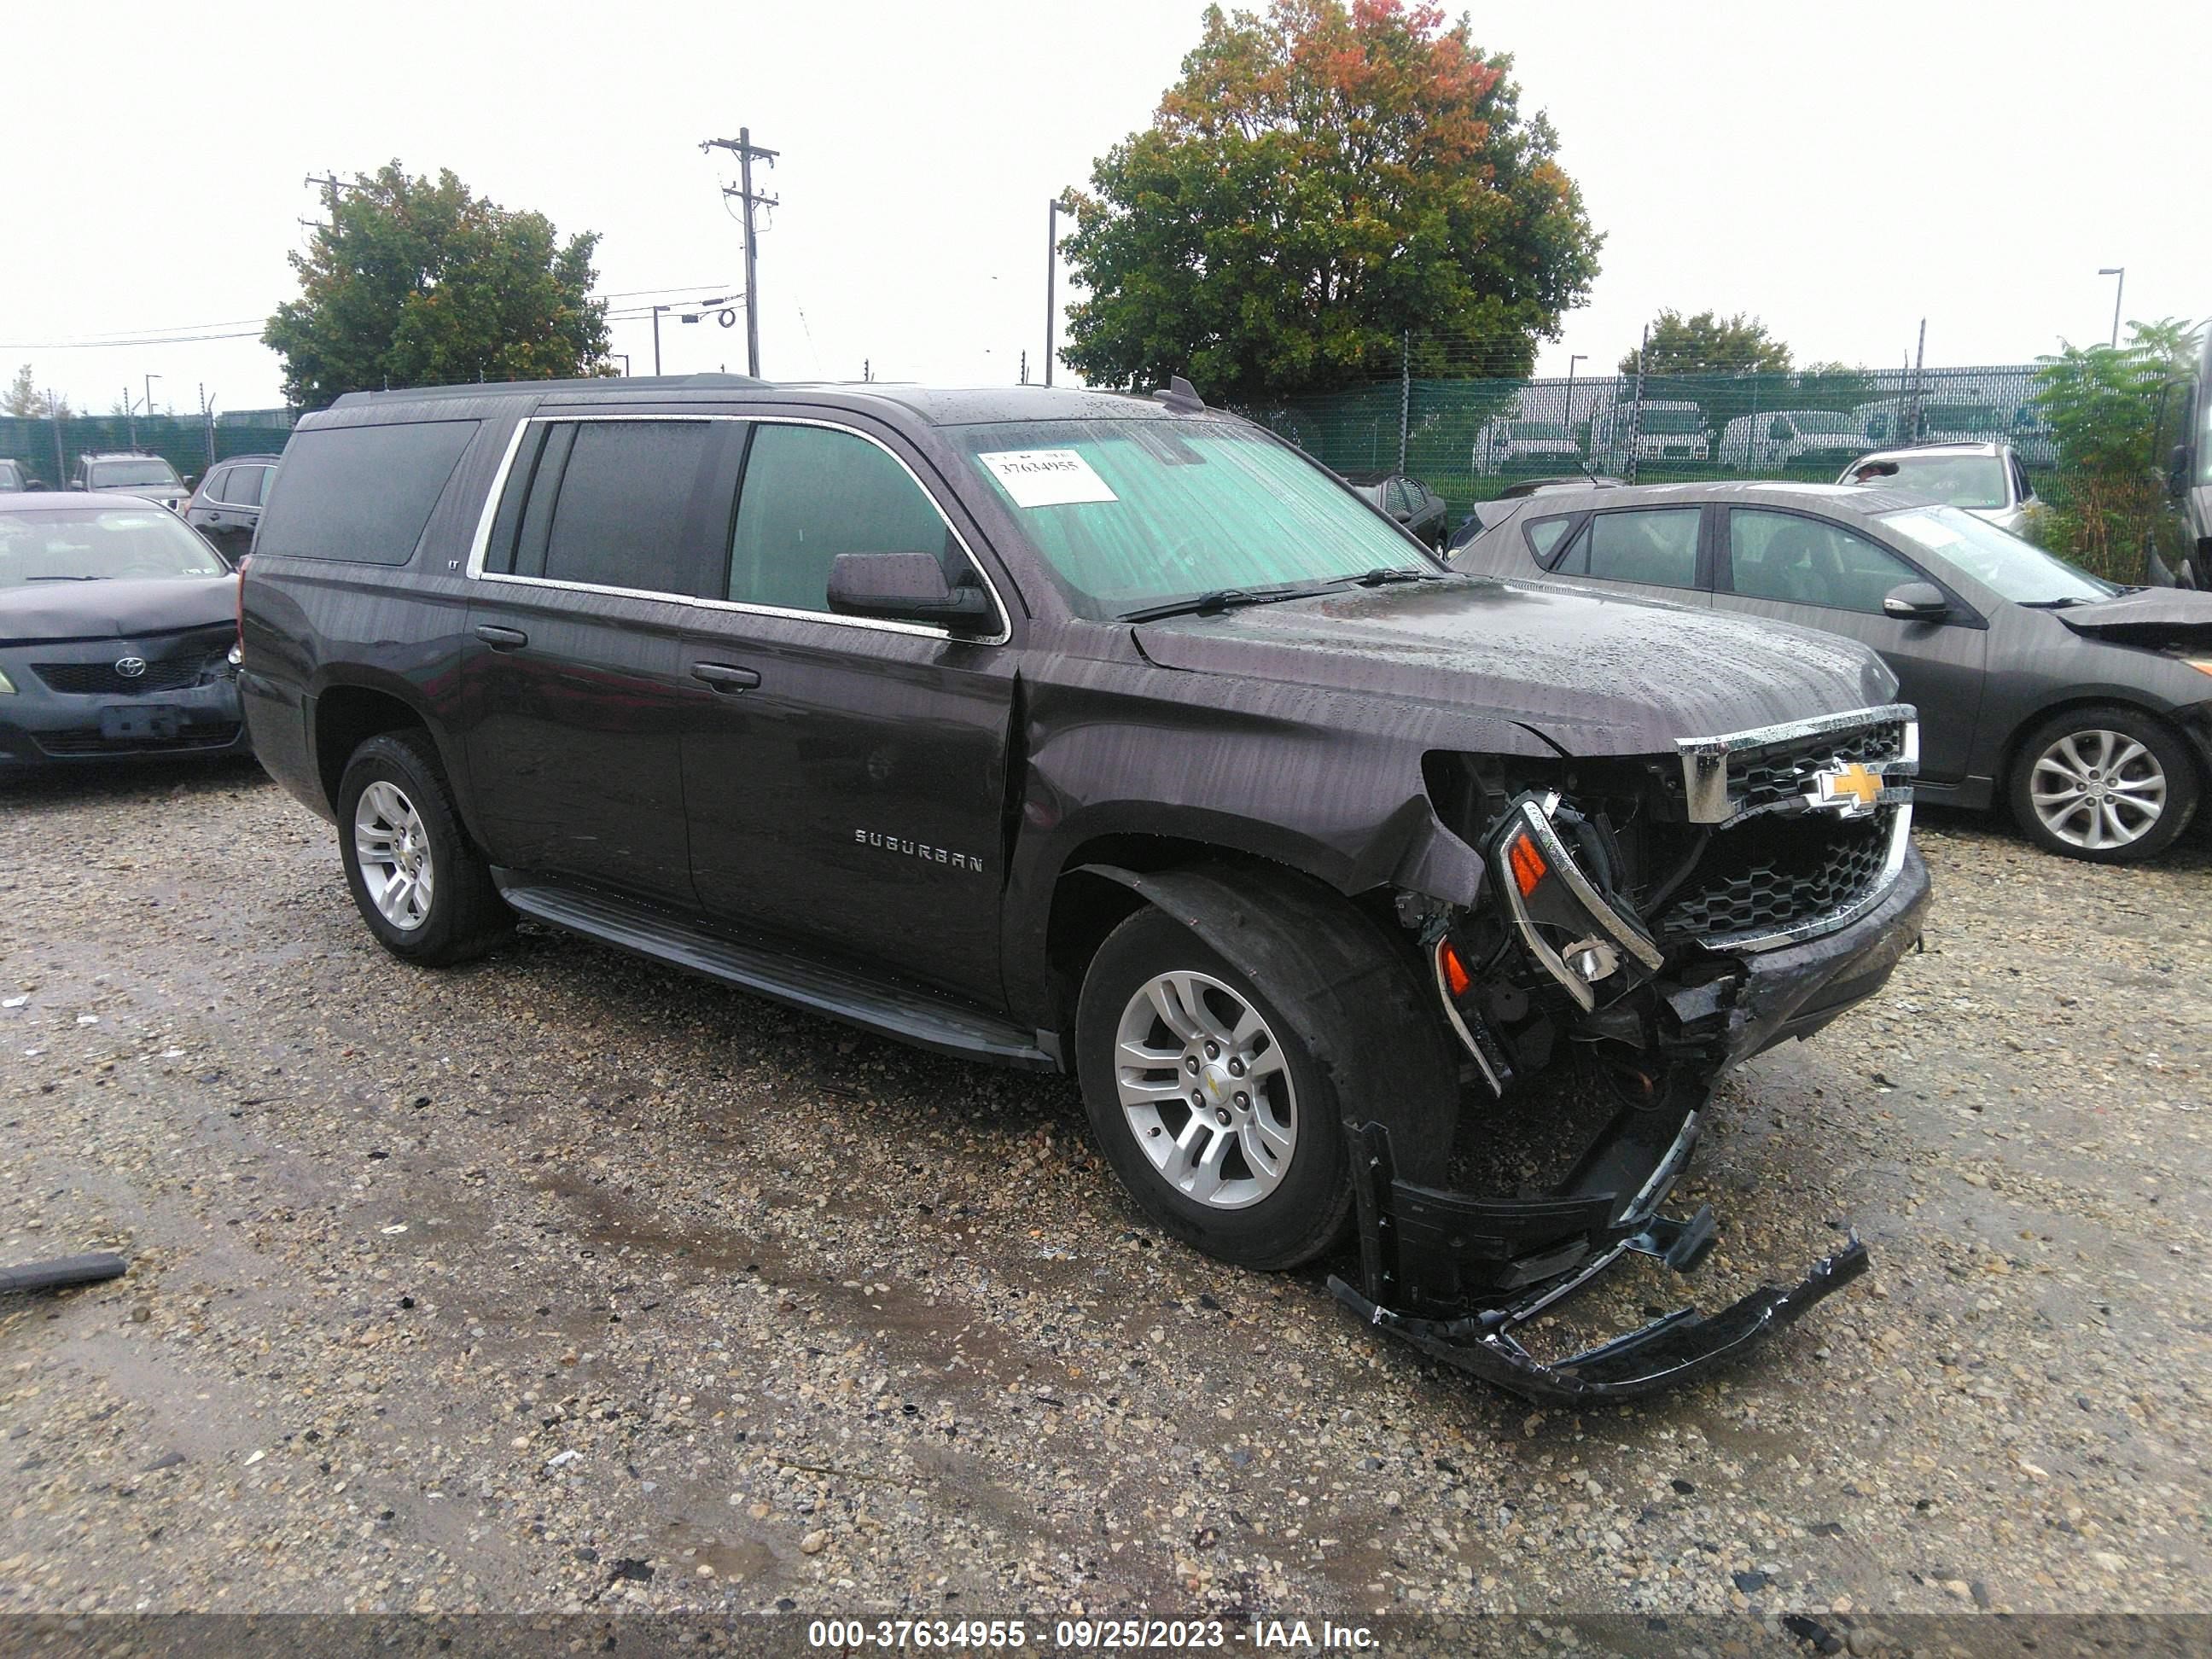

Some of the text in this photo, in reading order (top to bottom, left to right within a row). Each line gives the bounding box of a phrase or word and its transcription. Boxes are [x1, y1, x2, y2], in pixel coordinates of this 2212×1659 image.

[999, 461, 1079, 474] 37634955
[448, 560, 461, 571] LT
[854, 829, 983, 873] SUBURBAN
